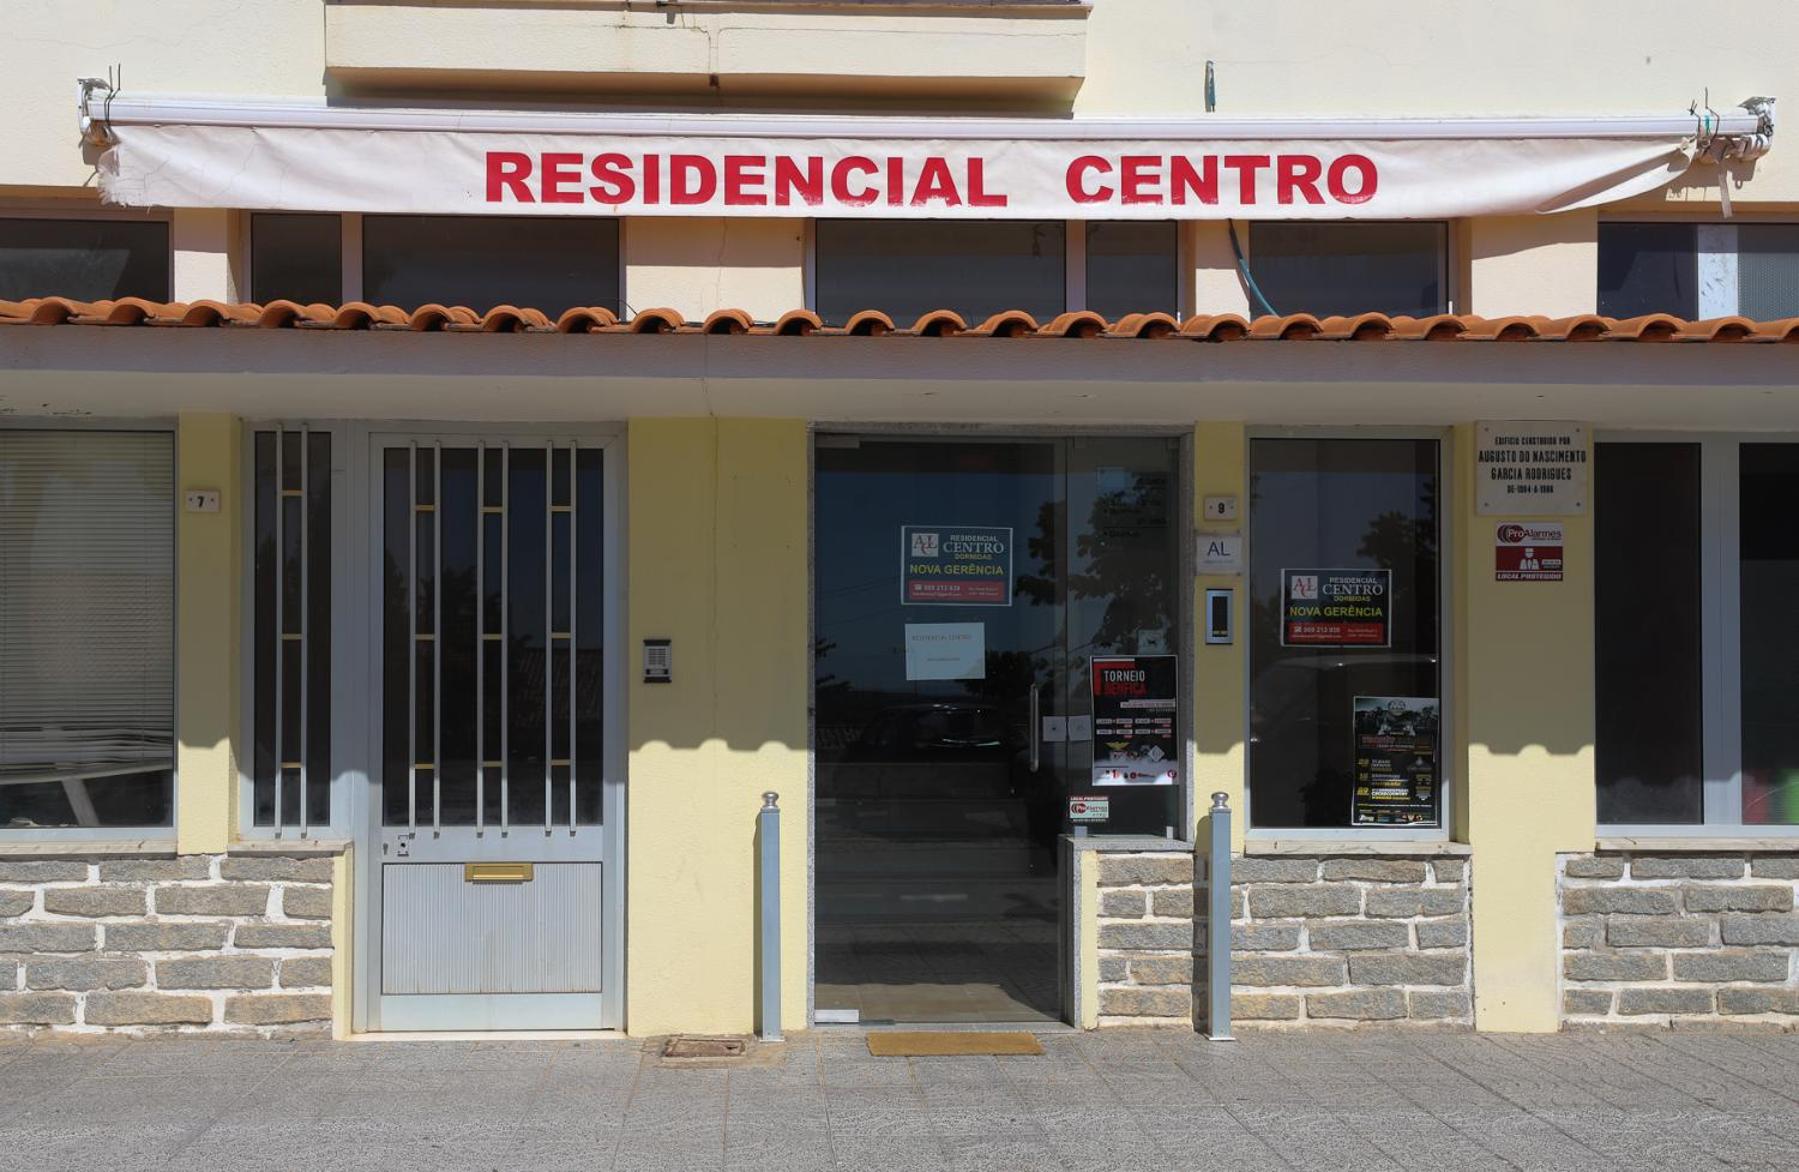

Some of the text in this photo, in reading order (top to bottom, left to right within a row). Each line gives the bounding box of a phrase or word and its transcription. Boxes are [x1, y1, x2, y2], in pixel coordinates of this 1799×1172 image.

[486, 151, 1379, 207] RESIDENCIAL CENTRO
[1479, 450, 1586, 463] AUGUSTO DO NASCIMENTO
[1491, 467, 1571, 480] GARCIA RODRIGUES
[197, 495, 205, 508] 7
[1217, 502, 1225, 514] 9
[943, 541, 1004, 554] CENTRO
[1207, 541, 1230, 556] AL
[910, 562, 1004, 575] NOVA GERÊNCIA
[1329, 576, 1376, 584] RESIDENCIAL
[1322, 583, 1383, 596] CENTRO
[1289, 604, 1383, 617] NOVA GERÊNCIA
[1104, 670, 1145, 682] TORNEIO
